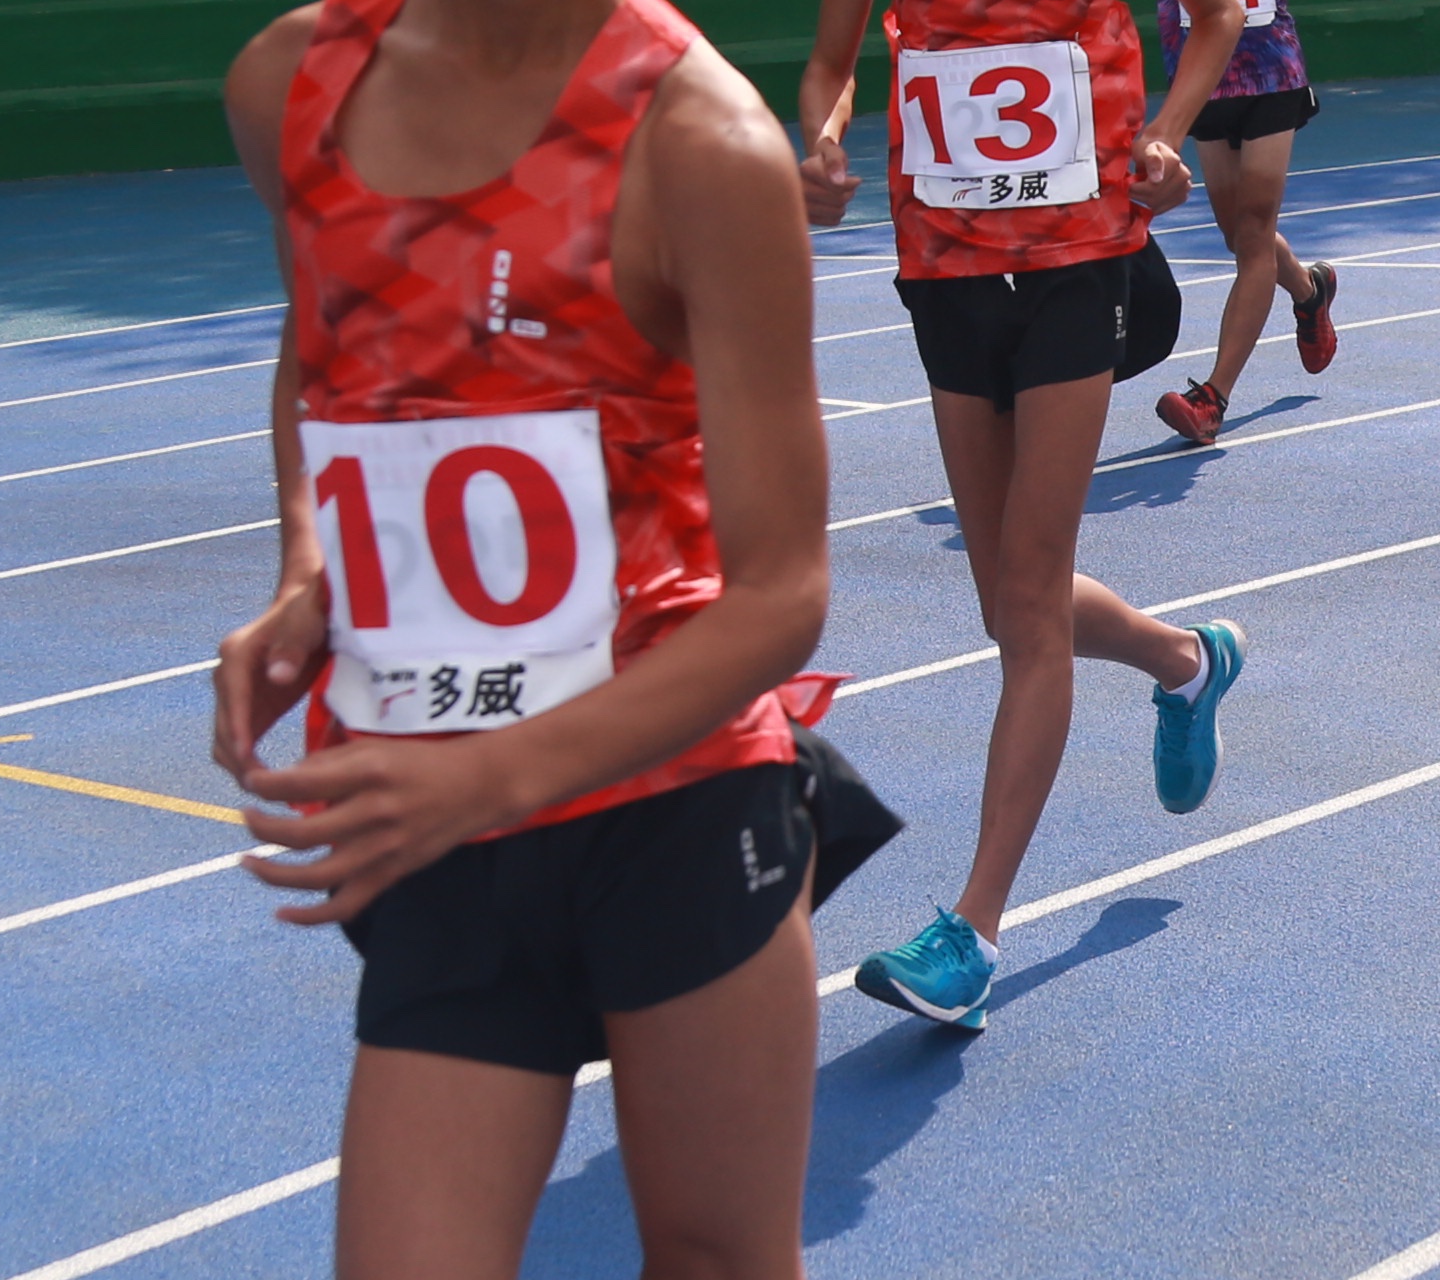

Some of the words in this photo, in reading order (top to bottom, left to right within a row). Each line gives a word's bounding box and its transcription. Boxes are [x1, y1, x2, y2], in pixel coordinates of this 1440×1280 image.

[904, 66, 1057, 164] 13
[989, 172, 1049, 204] 多威
[315, 443, 578, 630] 10
[428, 662, 526, 720] 多威
